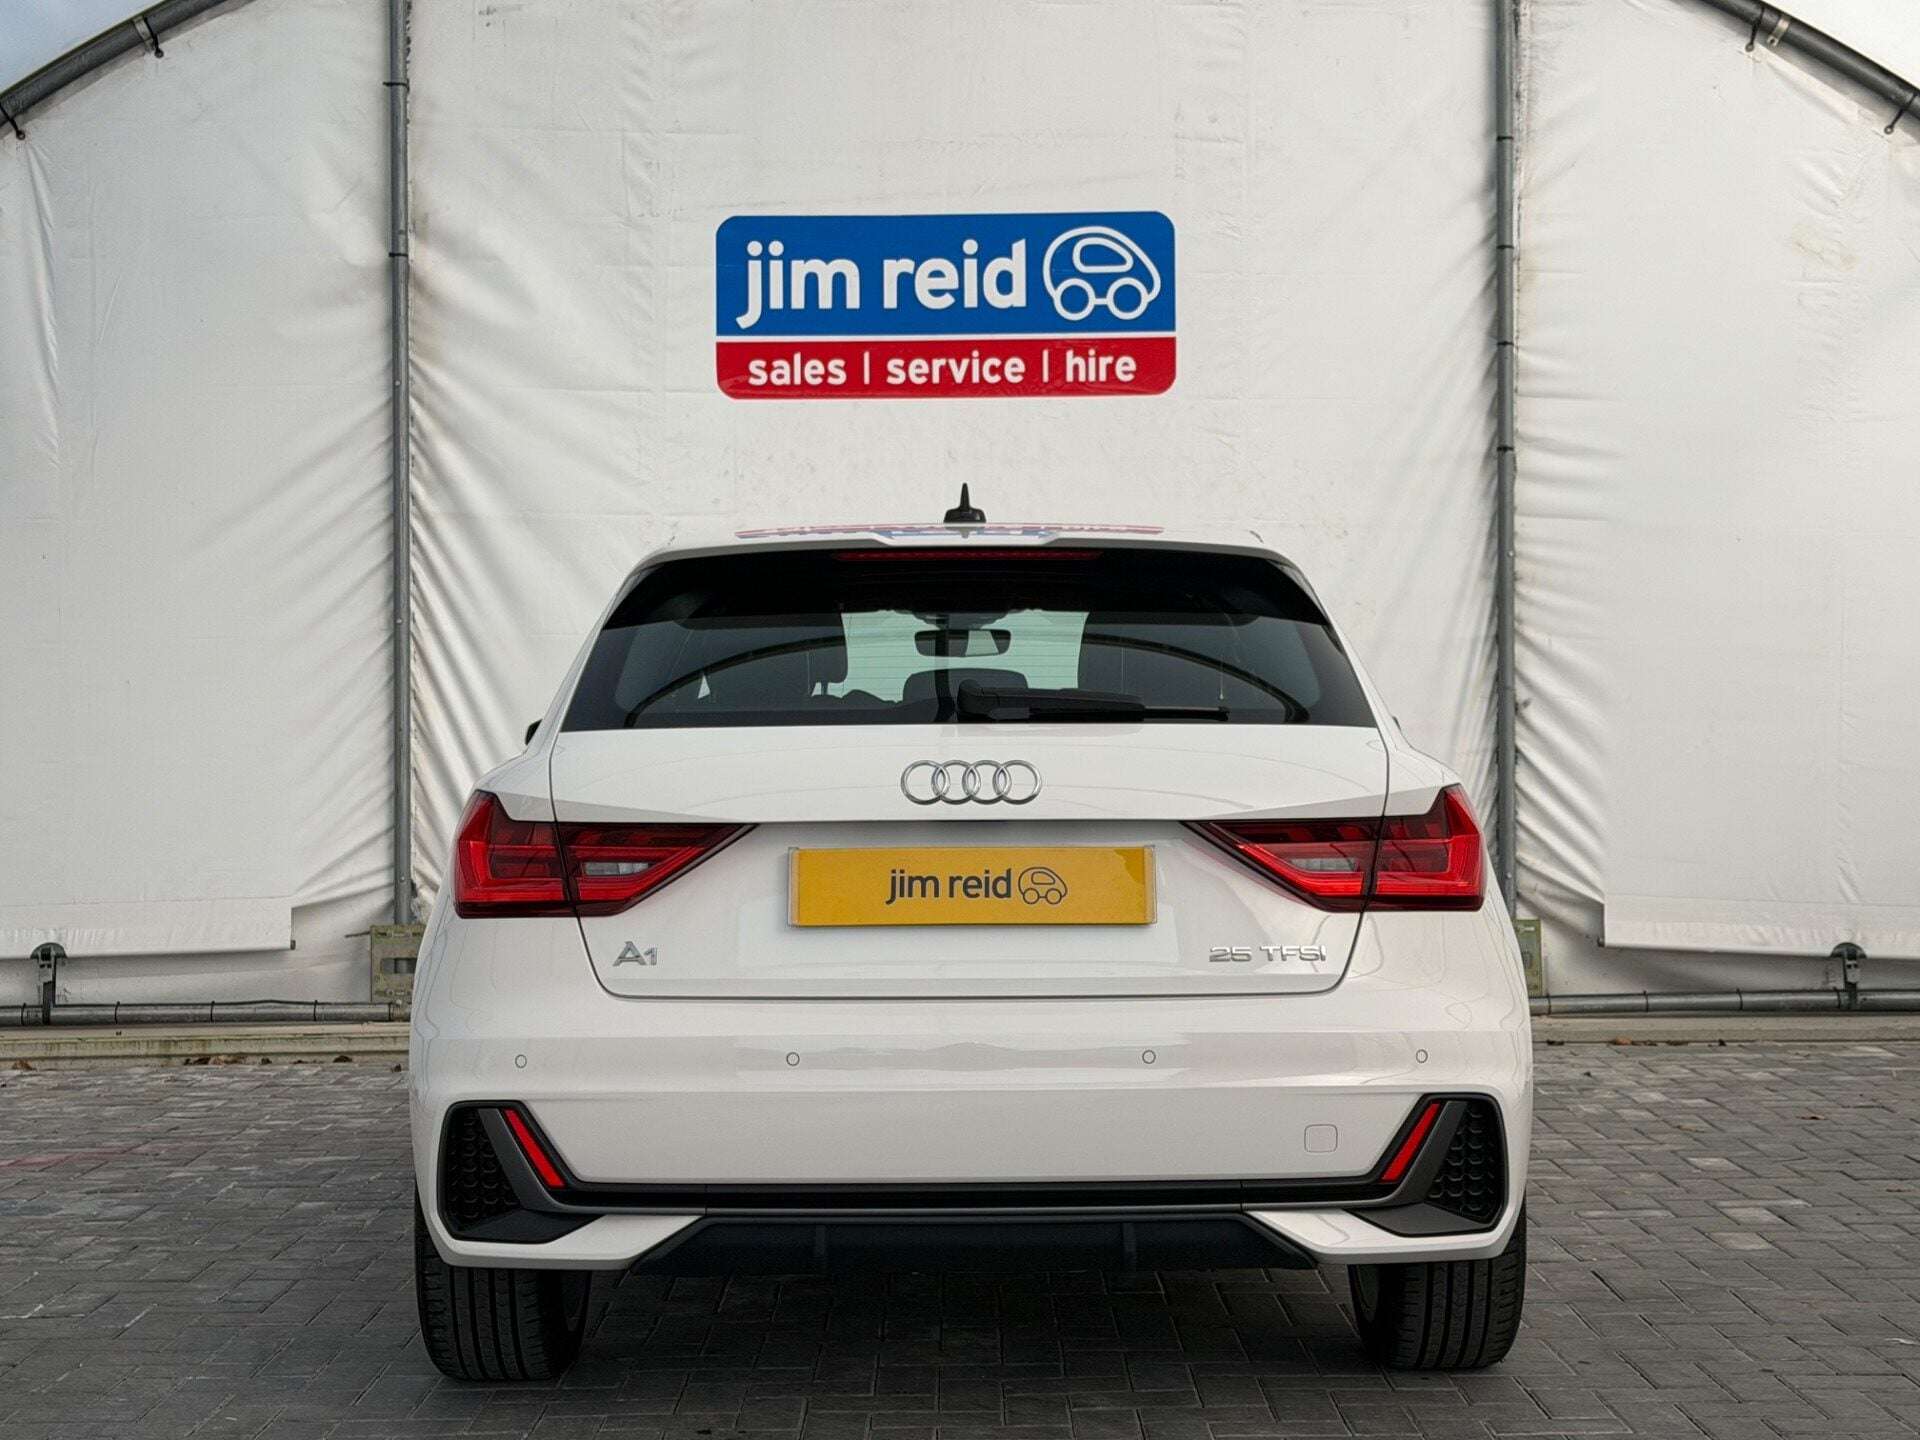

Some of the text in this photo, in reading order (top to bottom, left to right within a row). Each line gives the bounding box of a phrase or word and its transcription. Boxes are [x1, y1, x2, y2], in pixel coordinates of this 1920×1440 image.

[735, 238, 1027, 329] jim reid
[747, 348, 1137, 386] sales service hire
[885, 868, 1012, 905] jim reid
[612, 940, 658, 966] A1
[1209, 945, 1327, 962] 25 TFSI
